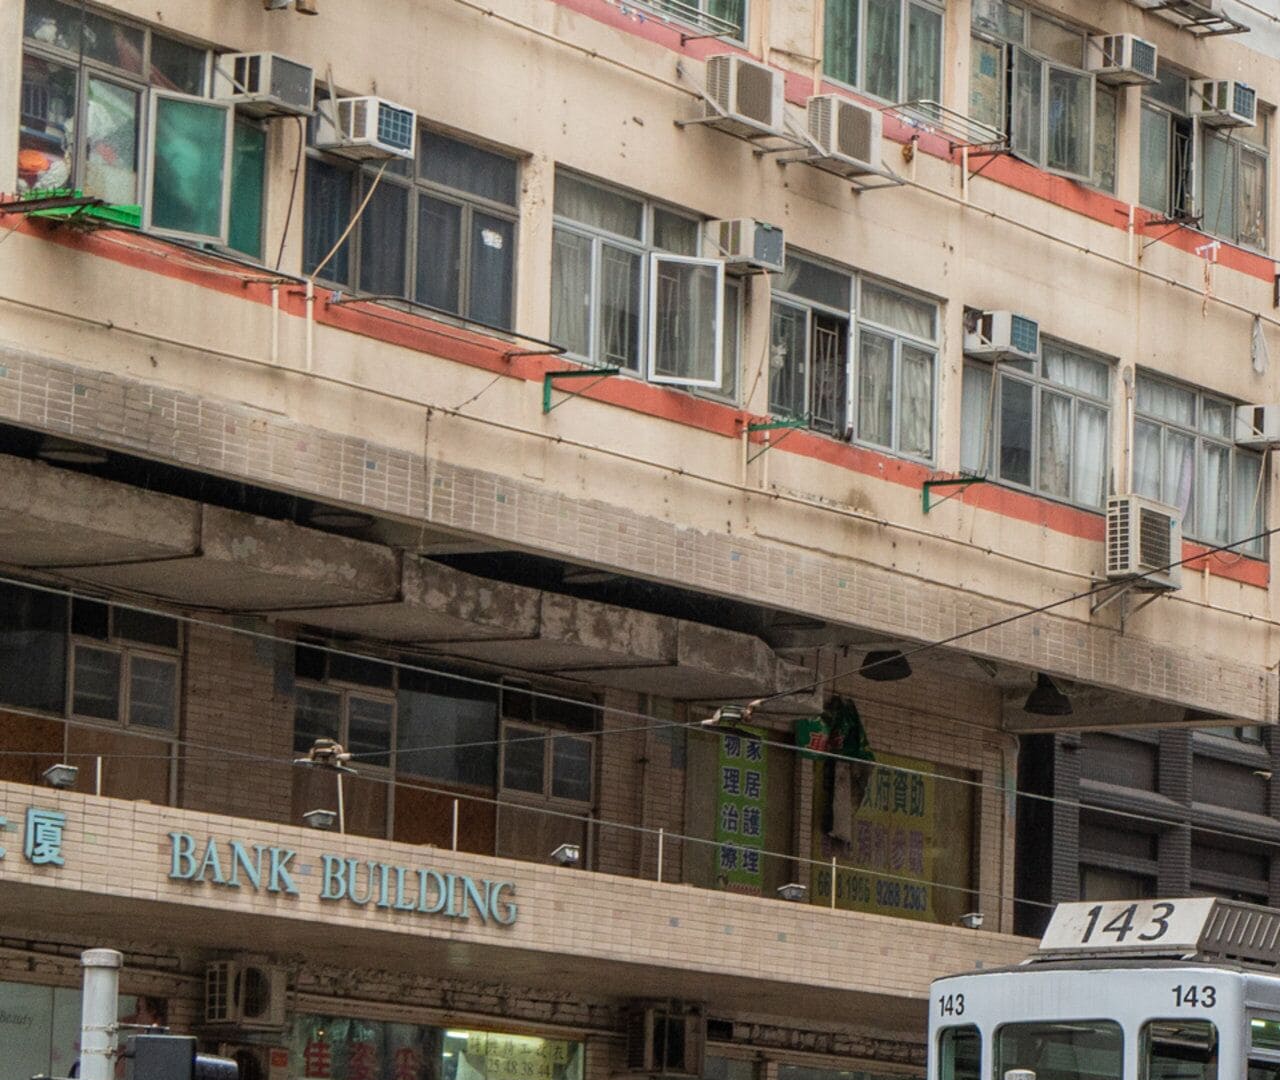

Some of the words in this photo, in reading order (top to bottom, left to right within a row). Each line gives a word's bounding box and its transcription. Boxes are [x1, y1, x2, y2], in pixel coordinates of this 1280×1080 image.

[168, 832, 298, 894] BANK
[320, 853, 519, 926] BUILDING
[1081, 903, 1176, 944] 143
[939, 993, 965, 1016] 143
[1172, 984, 1216, 1008] 143
